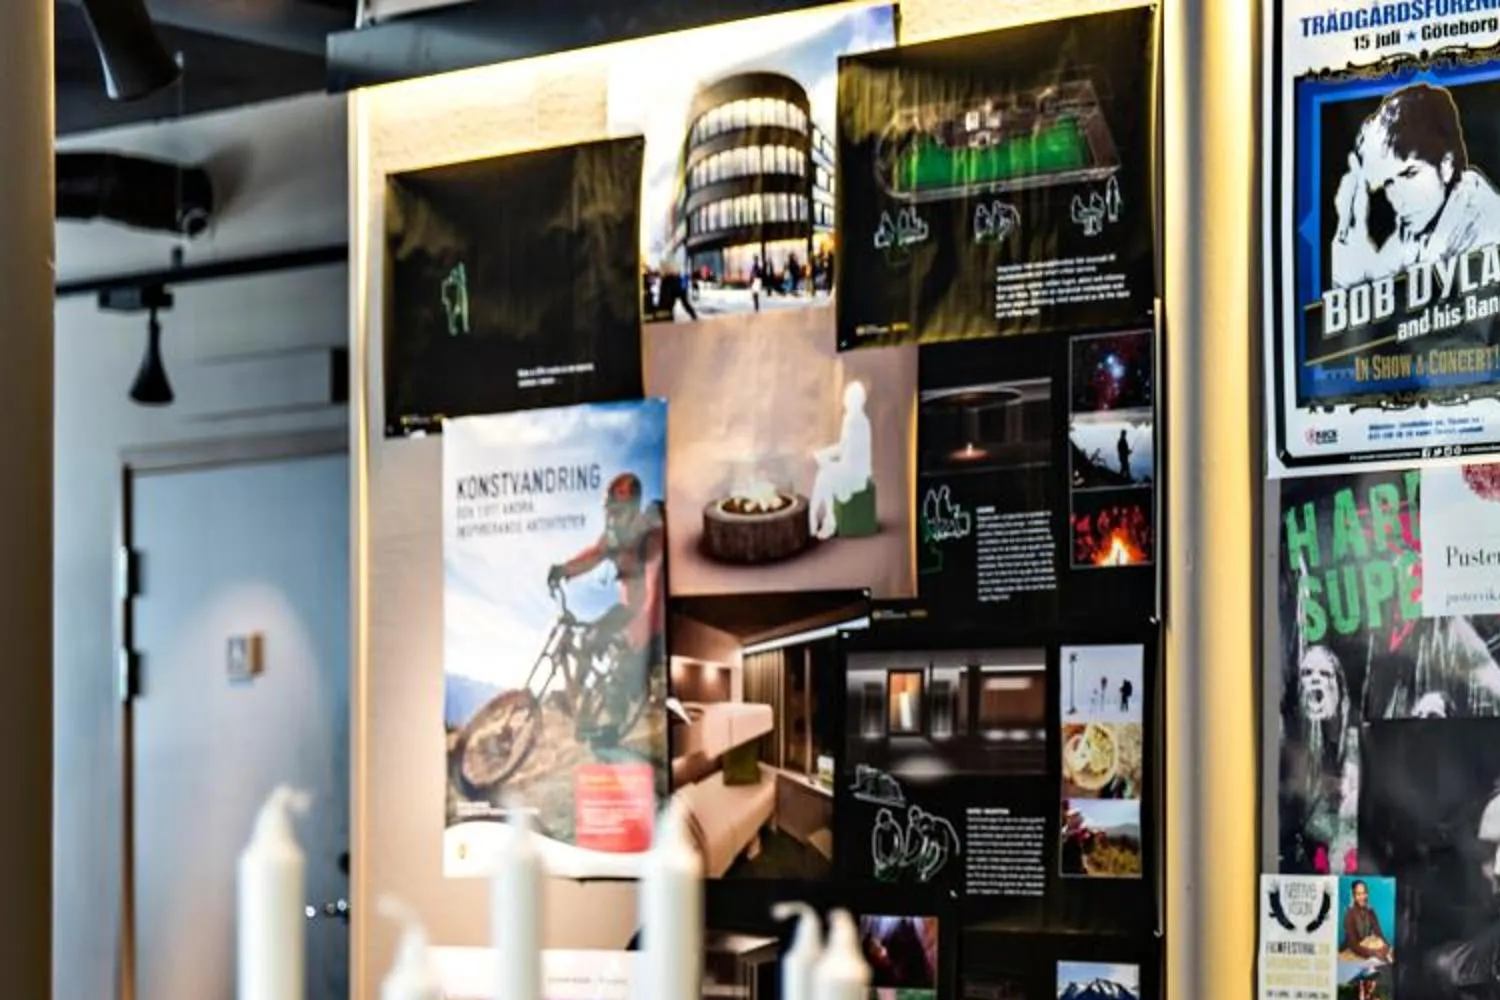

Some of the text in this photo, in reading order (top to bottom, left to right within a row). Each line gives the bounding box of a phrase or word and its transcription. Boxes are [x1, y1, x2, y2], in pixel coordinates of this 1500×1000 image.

[1354, 16, 1499, 50] 15 juli Göteborg
[1323, 280, 1397, 337] BOB
[1397, 314, 1430, 343] and
[1431, 302, 1463, 335] his
[1372, 353, 1414, 379] SHOW
[455, 464, 602, 500] KONSTVANDRING
